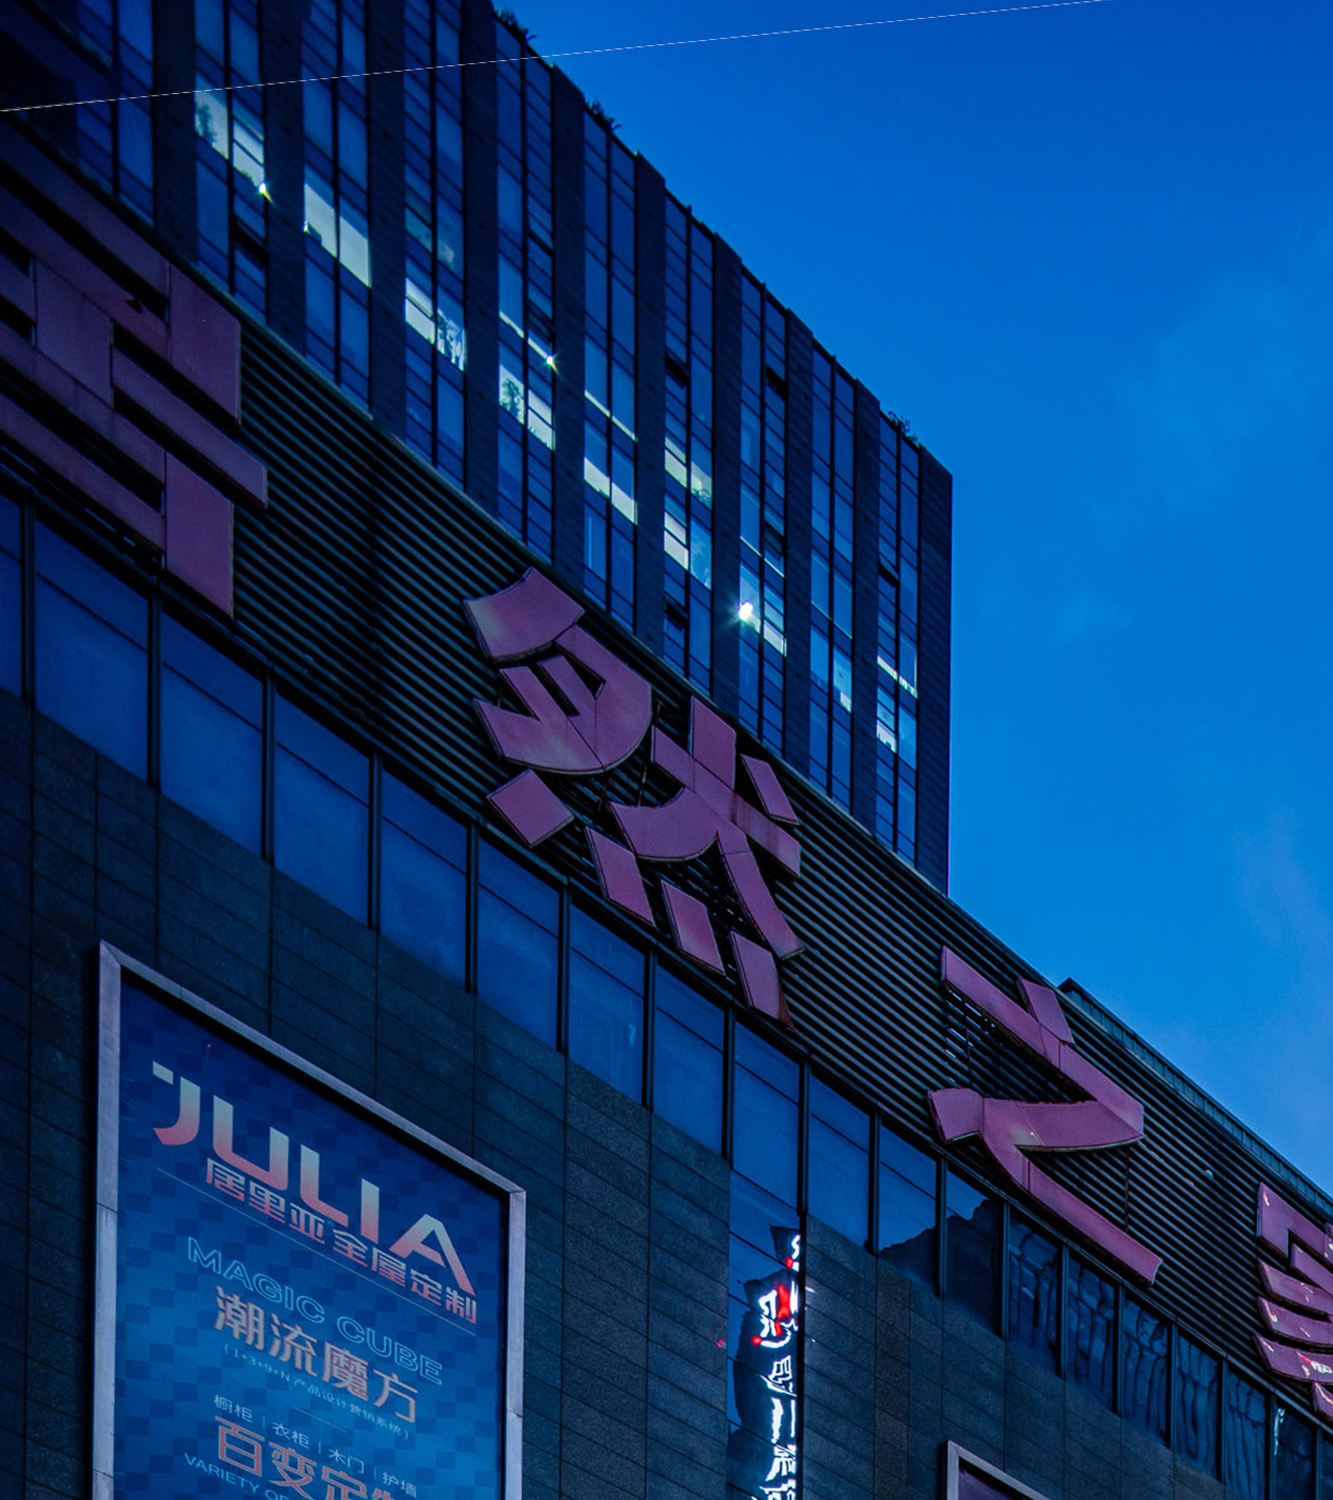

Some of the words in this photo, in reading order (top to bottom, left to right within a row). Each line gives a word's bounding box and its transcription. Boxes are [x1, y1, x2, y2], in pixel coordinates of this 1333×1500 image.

[152, 1060, 477, 1297] JULIA
[188, 1236, 326, 1324] MAGIC
[337, 1315, 443, 1386] CUBE
[214, 1284, 418, 1423] 潮流魔方
[184, 1452, 261, 1494] VARIETY
[214, 1394, 254, 1425] 橱柜
[272, 1421, 310, 1449] 衣柜
[328, 1448, 365, 1474] 木门
[382, 1471, 417, 1498] 护墙
